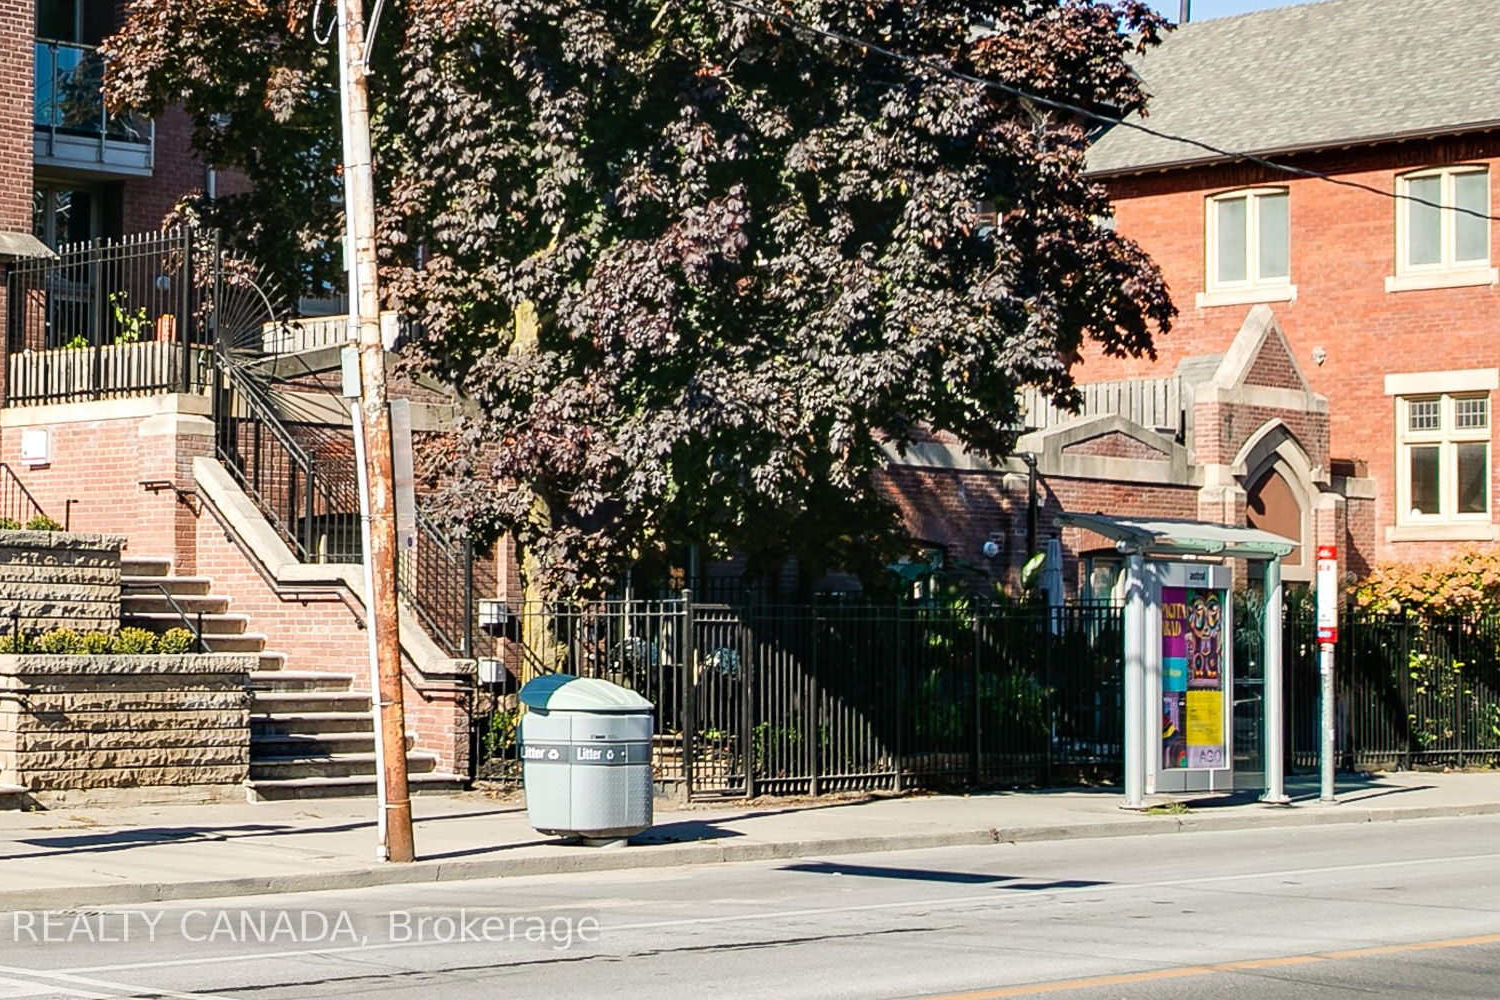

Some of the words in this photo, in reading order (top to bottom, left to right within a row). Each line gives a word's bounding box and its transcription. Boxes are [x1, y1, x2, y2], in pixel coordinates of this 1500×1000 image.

[520, 745, 546, 760] Litter
[576, 746, 602, 760] Litter
[1200, 749, 1221, 763] AGO
